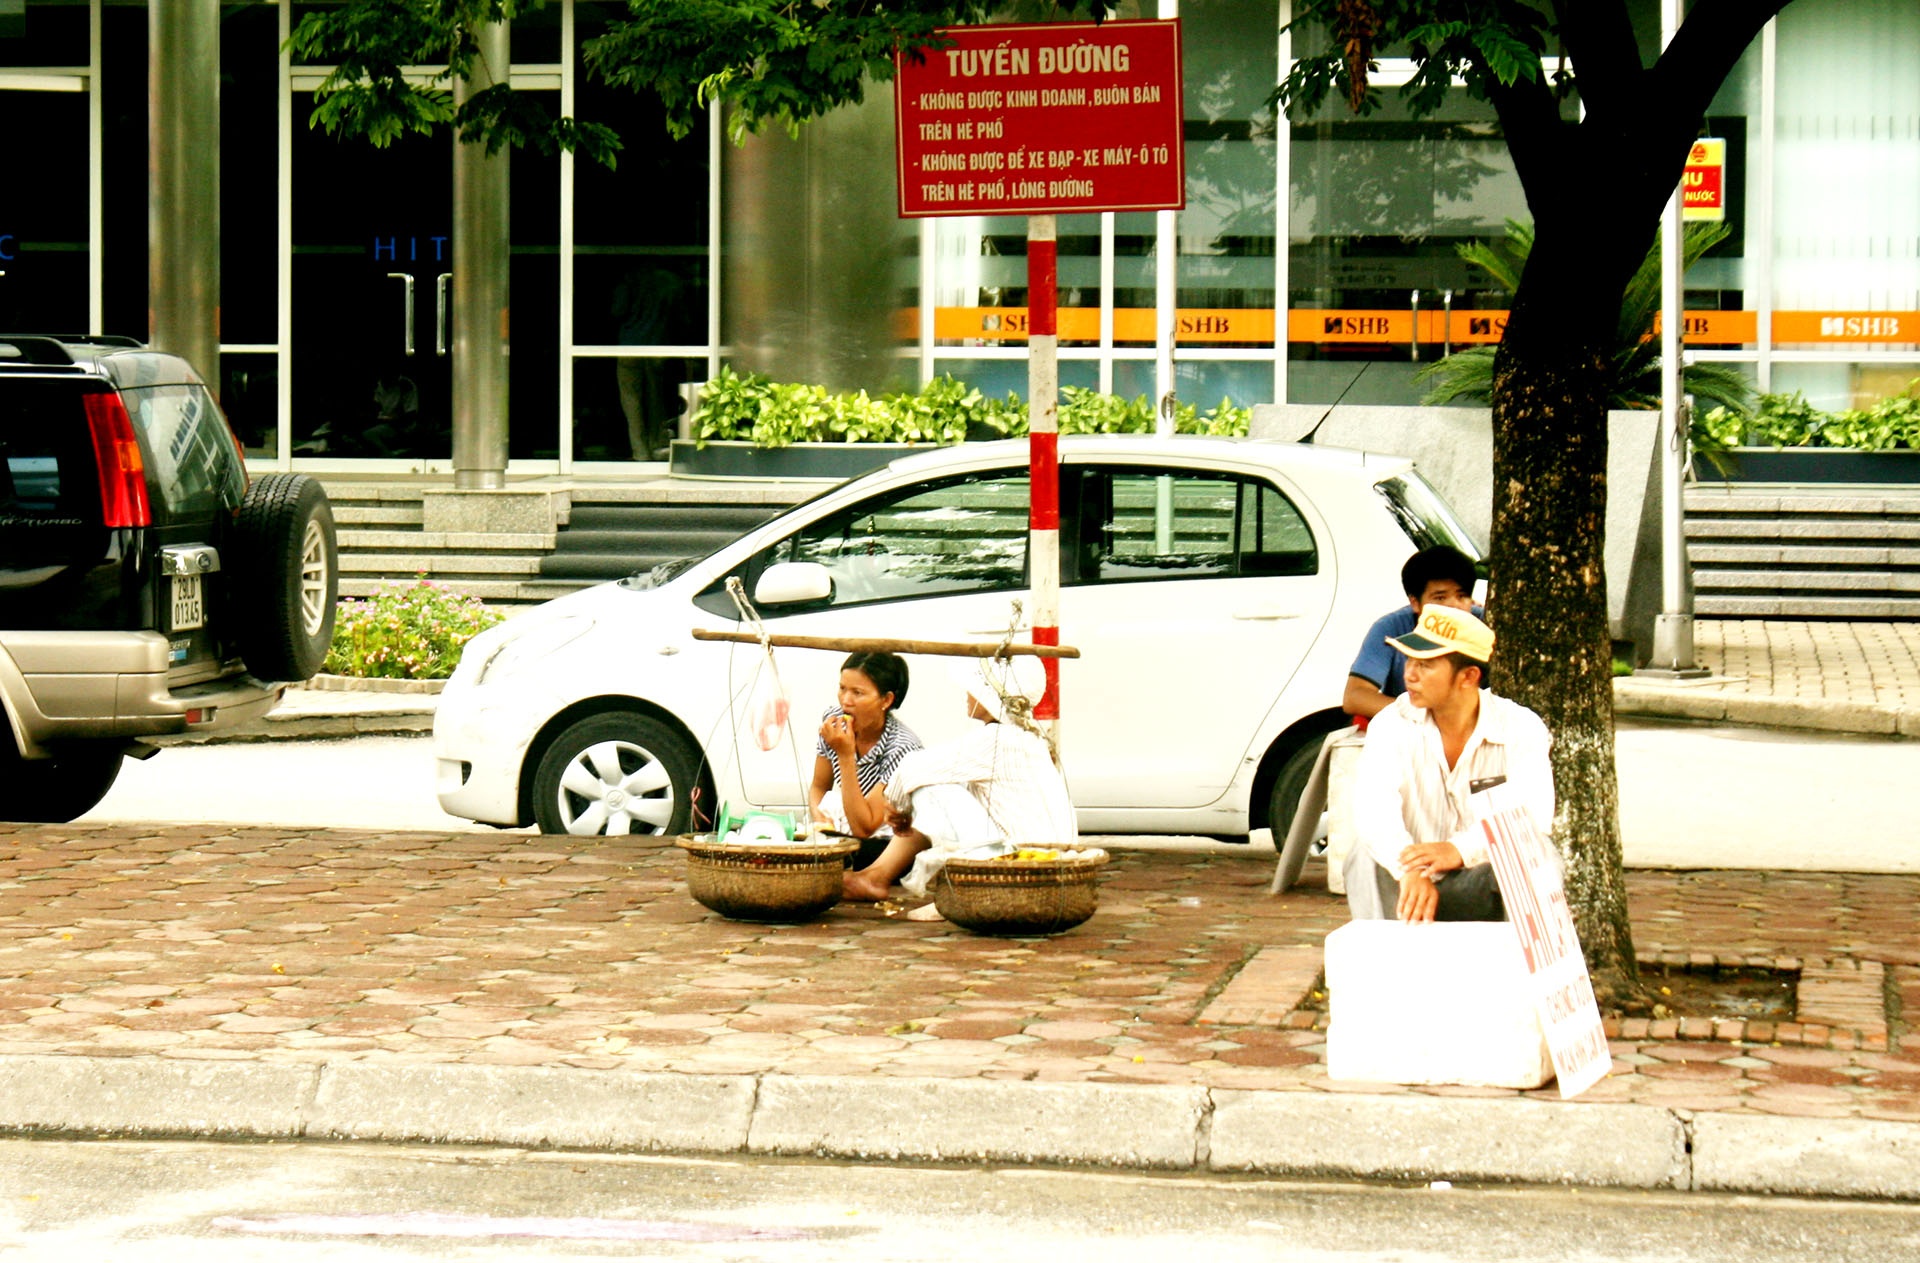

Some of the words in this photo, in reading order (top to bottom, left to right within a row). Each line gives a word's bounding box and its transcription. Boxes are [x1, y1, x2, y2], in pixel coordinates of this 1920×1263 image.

[946, 40, 1029, 76] TUYẾN
[1038, 39, 1129, 74] ĐƯỜNG
[921, 89, 964, 110] KHÔNG
[968, 90, 1002, 111] ĐƯỢC
[1007, 90, 1037, 107] KINH
[1134, 83, 1160, 103] BÁN
[919, 120, 952, 140] TRÊN
[957, 119, 973, 139] HÈ
[977, 116, 1003, 138] PHỐ
[922, 150, 966, 171] KHÔNG
[970, 152, 1004, 172] ĐƯỢC
[1008, 145, 1025, 169] ĐỂ
[1029, 152, 1044, 168] XE
[1153, 144, 1168, 164] TÔ
[922, 181, 954, 201] TRÊN
[959, 181, 974, 200] HÈ
[1012, 179, 1045, 199] LÒNG
[1049, 175, 1093, 198] ĐƯỜNG
[1685, 190, 1715, 201] NƯỚC
[1181, 316, 1229, 333] SHB
[1345, 317, 1389, 334] SHB
[1846, 317, 1899, 337] SHB
